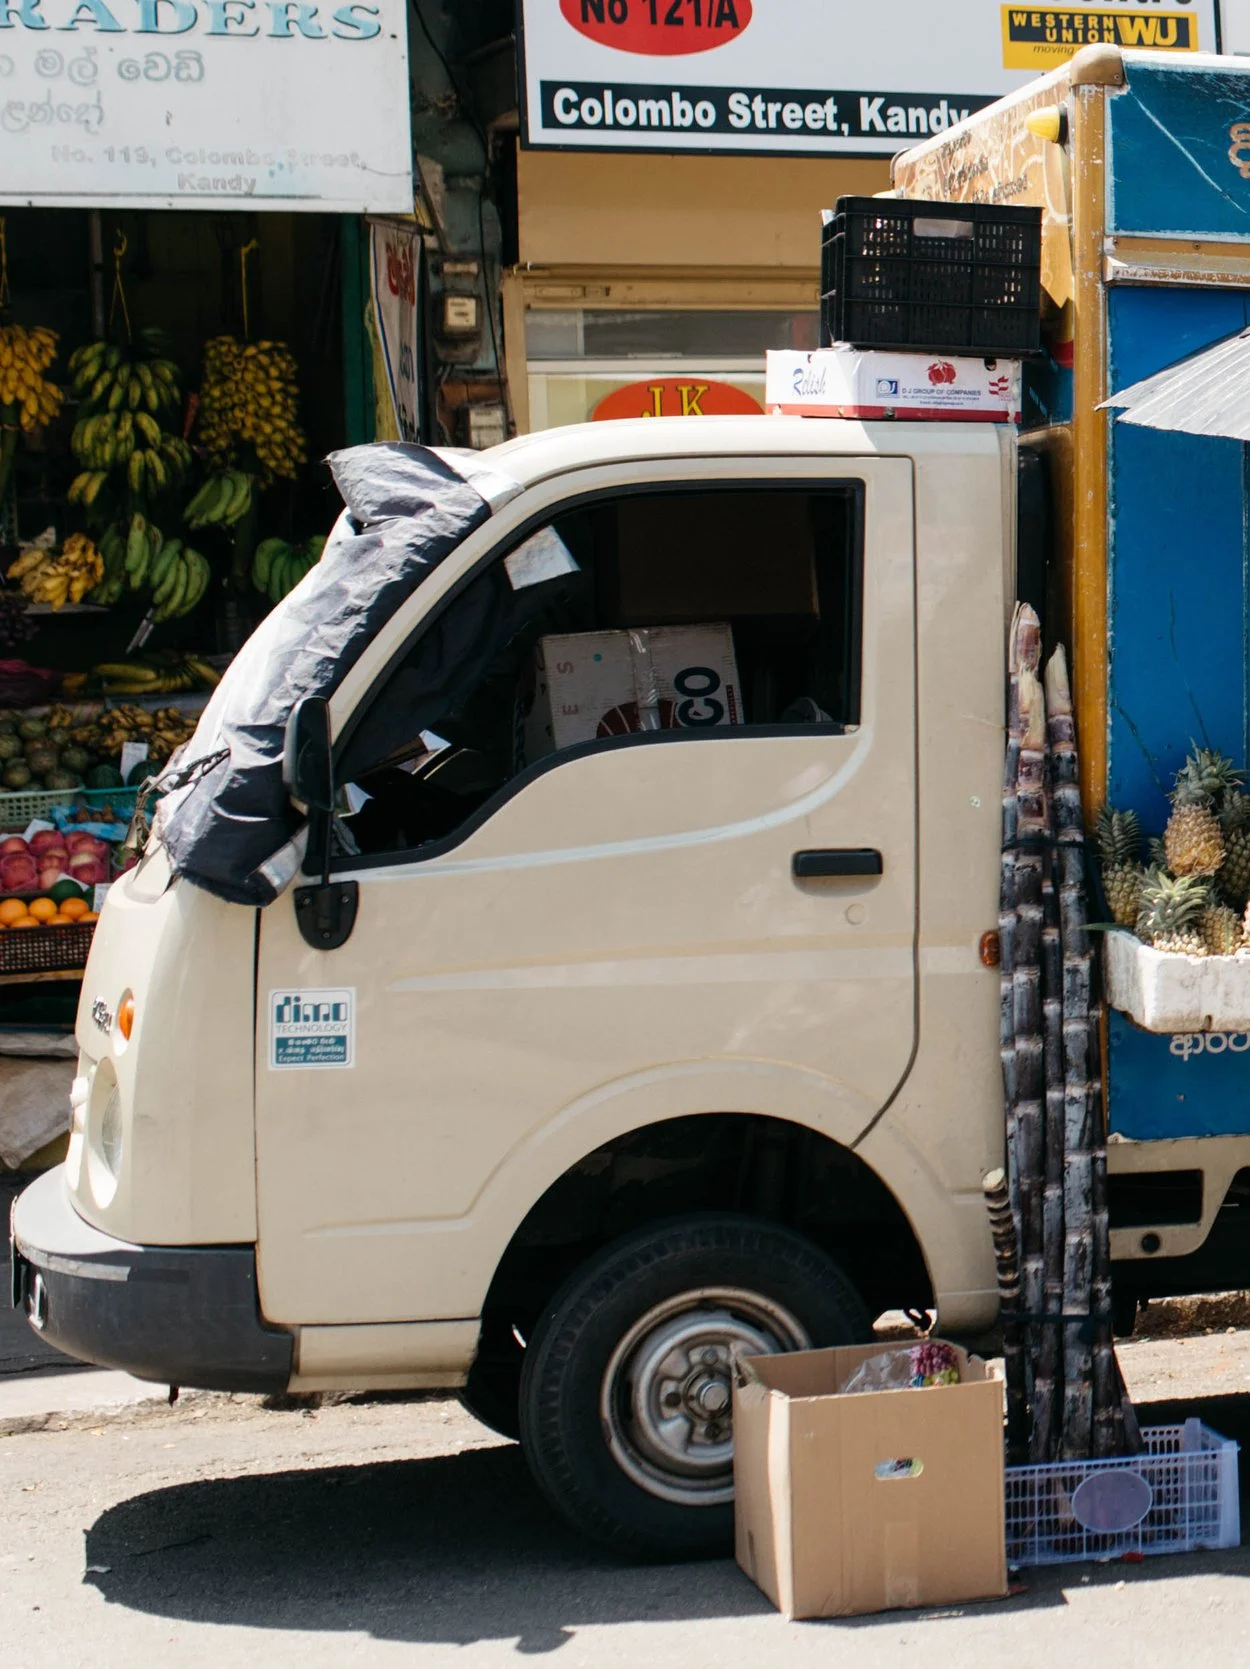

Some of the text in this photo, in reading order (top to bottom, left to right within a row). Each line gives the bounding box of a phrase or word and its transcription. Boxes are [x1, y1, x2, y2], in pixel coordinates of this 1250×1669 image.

[1012, 13, 1179, 46] WESTERN WU
[1045, 28, 1115, 43] UNION
[1033, 44, 1075, 56] moving
[552, 87, 717, 129] Colombo
[728, 92, 850, 137] Street,
[177, 172, 258, 195] Kandy
[276, 1024, 347, 1033] TECHNOLOGY
